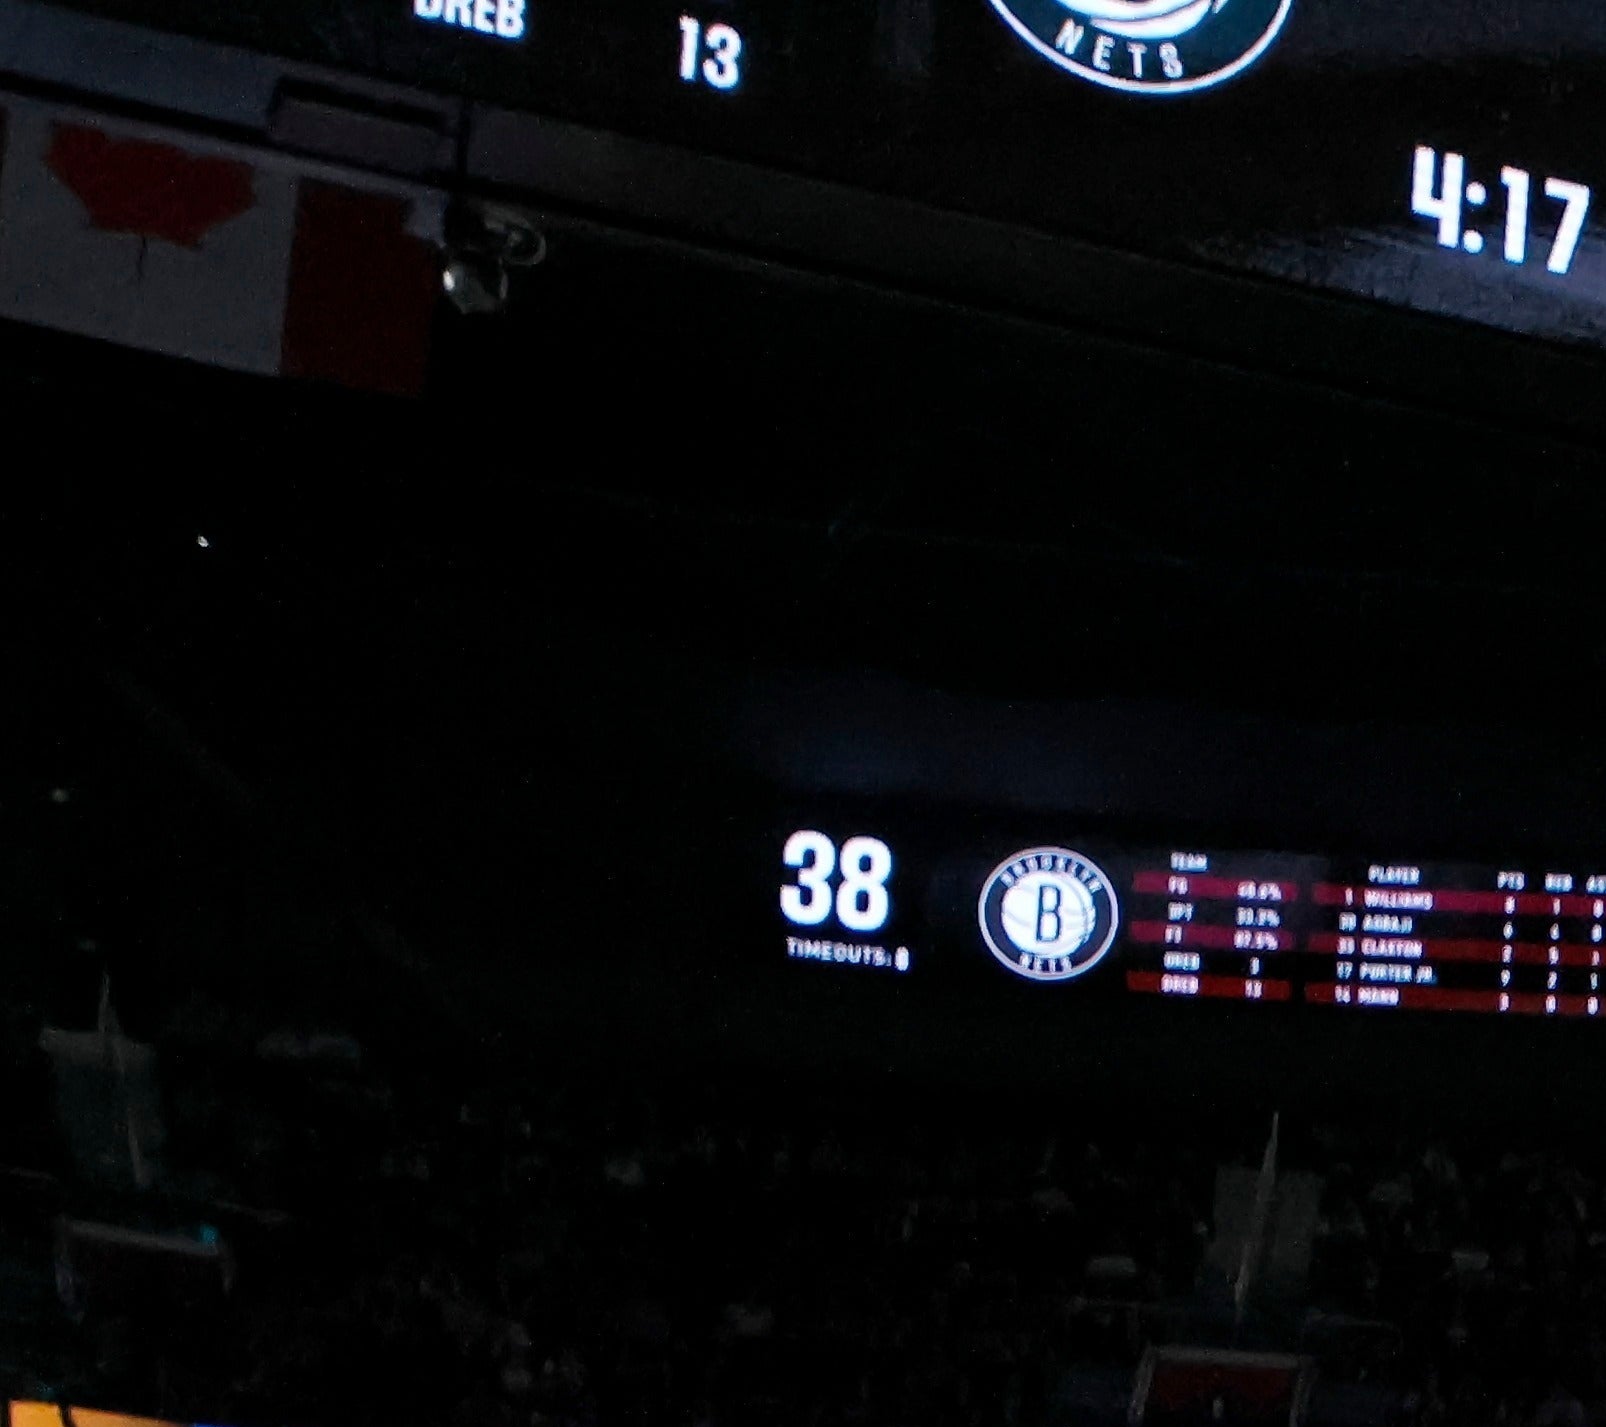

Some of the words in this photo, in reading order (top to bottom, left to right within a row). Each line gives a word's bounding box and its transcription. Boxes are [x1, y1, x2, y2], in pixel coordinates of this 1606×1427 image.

[677, 14, 743, 90] 13
[1055, 18, 1183, 79] NETS
[1410, 145, 1590, 274] 4:17
[780, 829, 891, 931] 38
[1036, 884, 1062, 941] B
